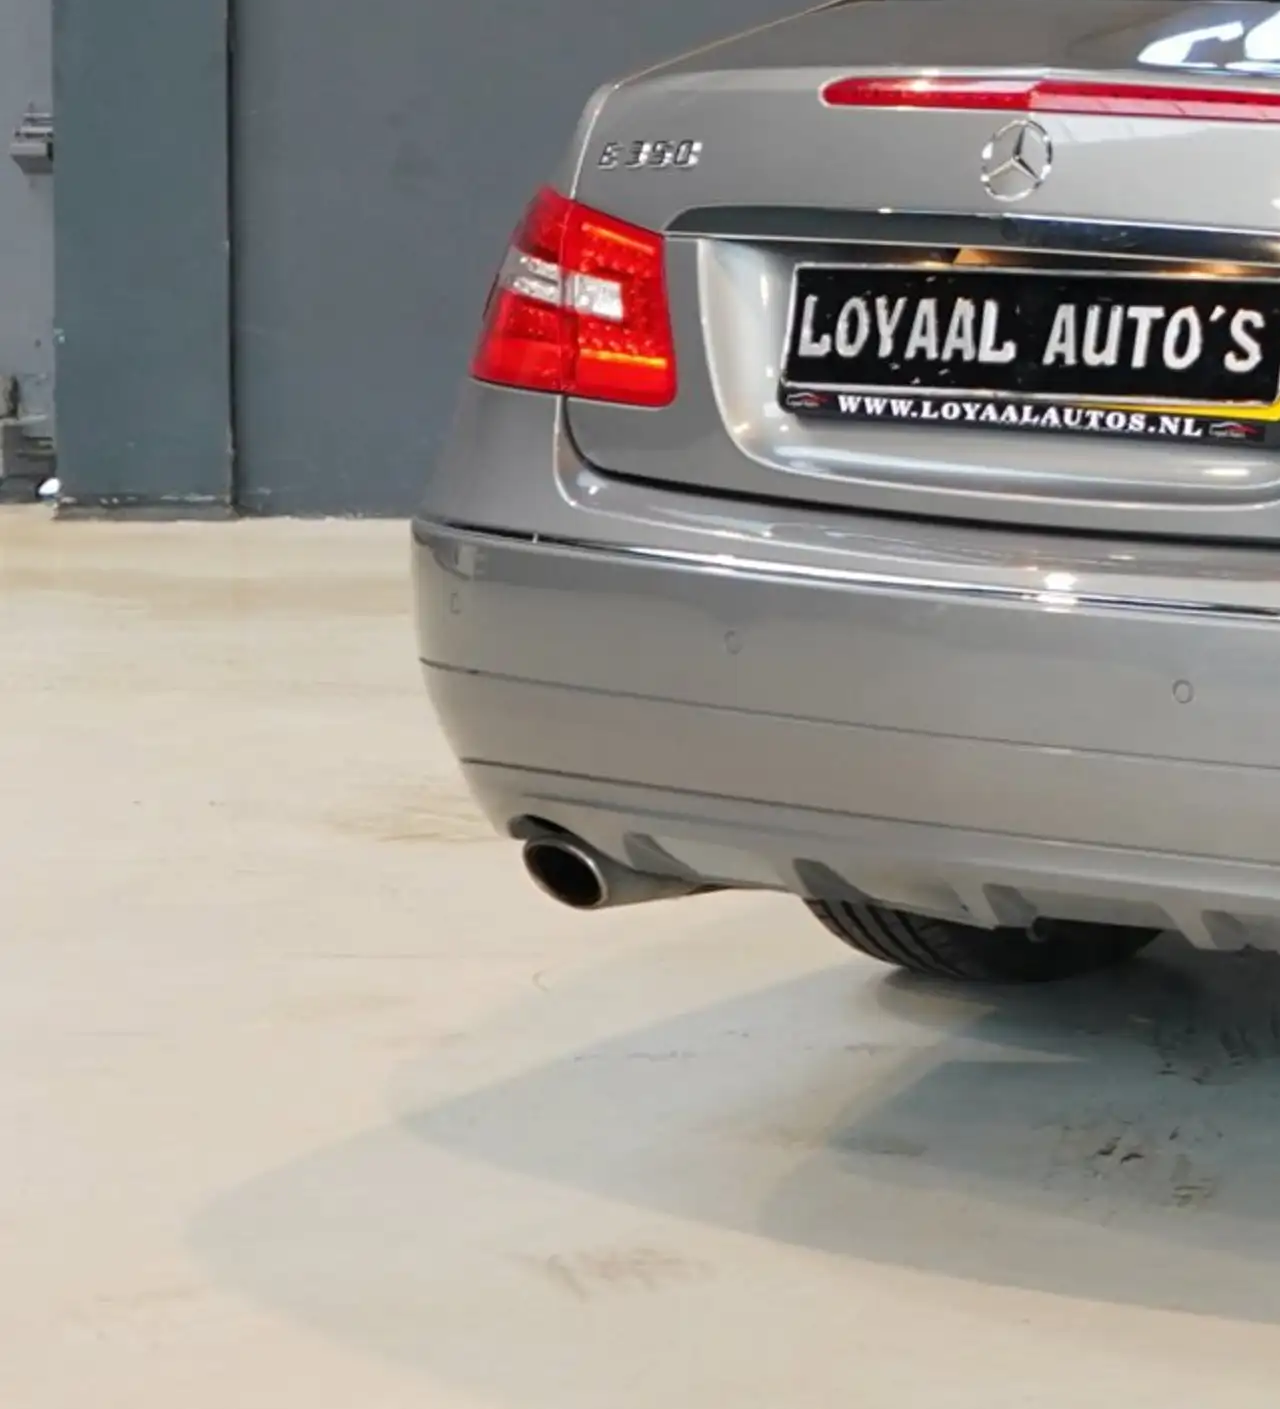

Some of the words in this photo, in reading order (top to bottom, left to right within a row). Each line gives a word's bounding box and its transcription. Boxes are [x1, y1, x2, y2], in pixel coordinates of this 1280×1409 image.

[797, 293, 1016, 364] LOYAAL
[1042, 305, 1265, 374] AUTO'S
[837, 394, 1203, 437] WWW.LOYAALAUTOS.NL
